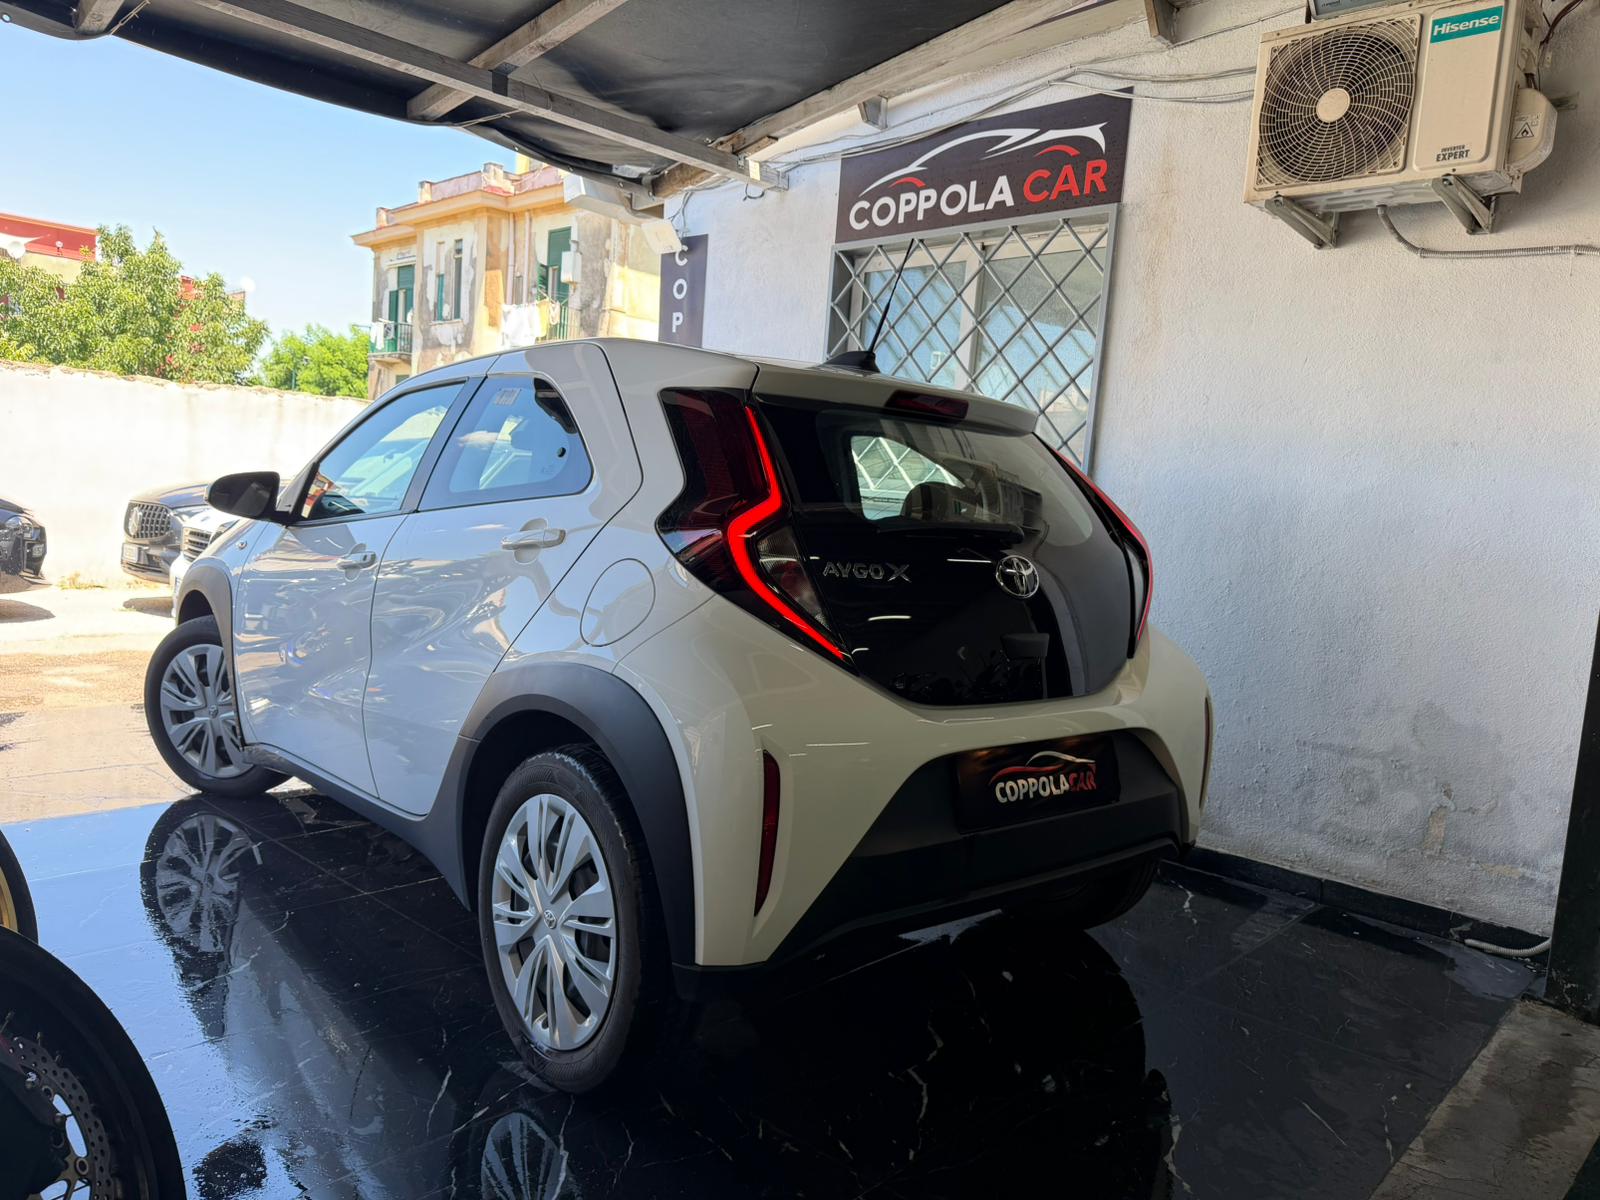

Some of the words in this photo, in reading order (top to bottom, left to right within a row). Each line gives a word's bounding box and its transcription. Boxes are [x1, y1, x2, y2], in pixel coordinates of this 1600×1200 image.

[1433, 14, 1500, 36] Hisense
[1436, 149, 1471, 162] EXPERT
[850, 175, 1015, 231] COPPOLA
[1023, 159, 1108, 202] CAR
[823, 561, 885, 580] AYGO
